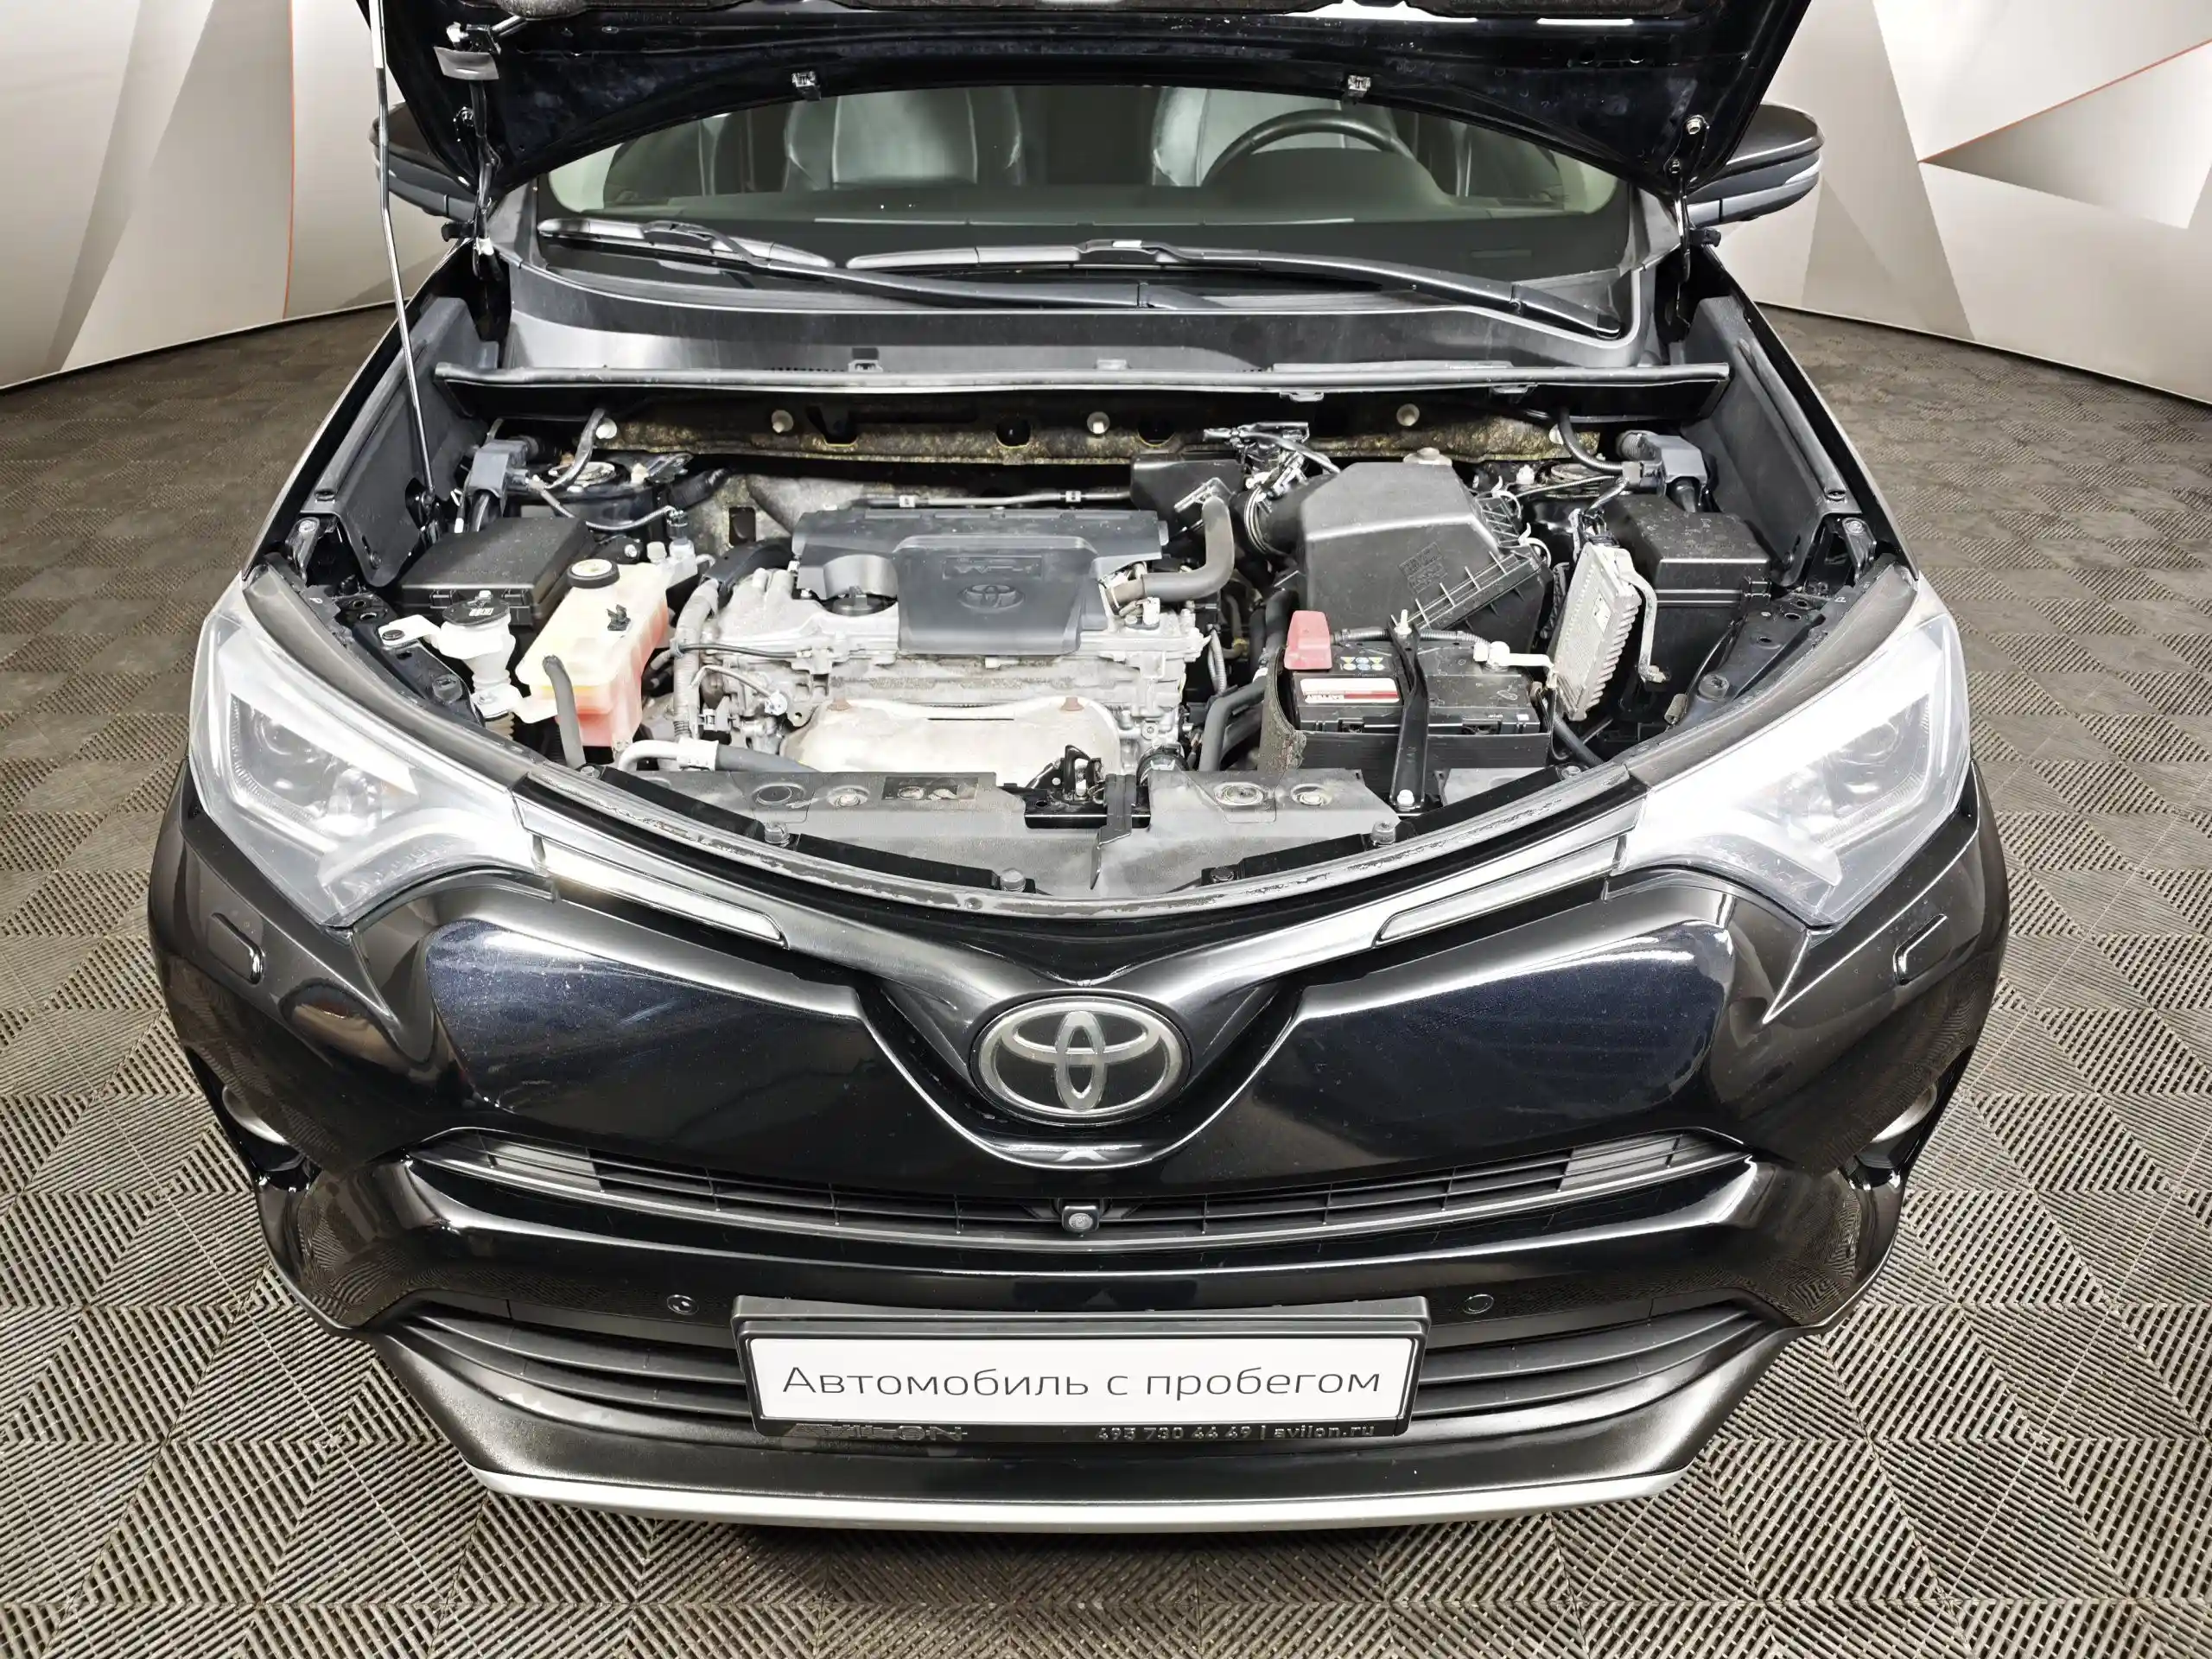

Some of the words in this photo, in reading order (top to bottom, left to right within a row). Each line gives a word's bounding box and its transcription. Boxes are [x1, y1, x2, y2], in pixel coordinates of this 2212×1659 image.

[782, 1366, 1089, 1396] Автомобиль
[1107, 1375, 1128, 1395] с
[1147, 1366, 1380, 1402] пробегом
[1143, 1427, 1185, 1440] 730
[1274, 1424, 1376, 1439] avilon.ru
